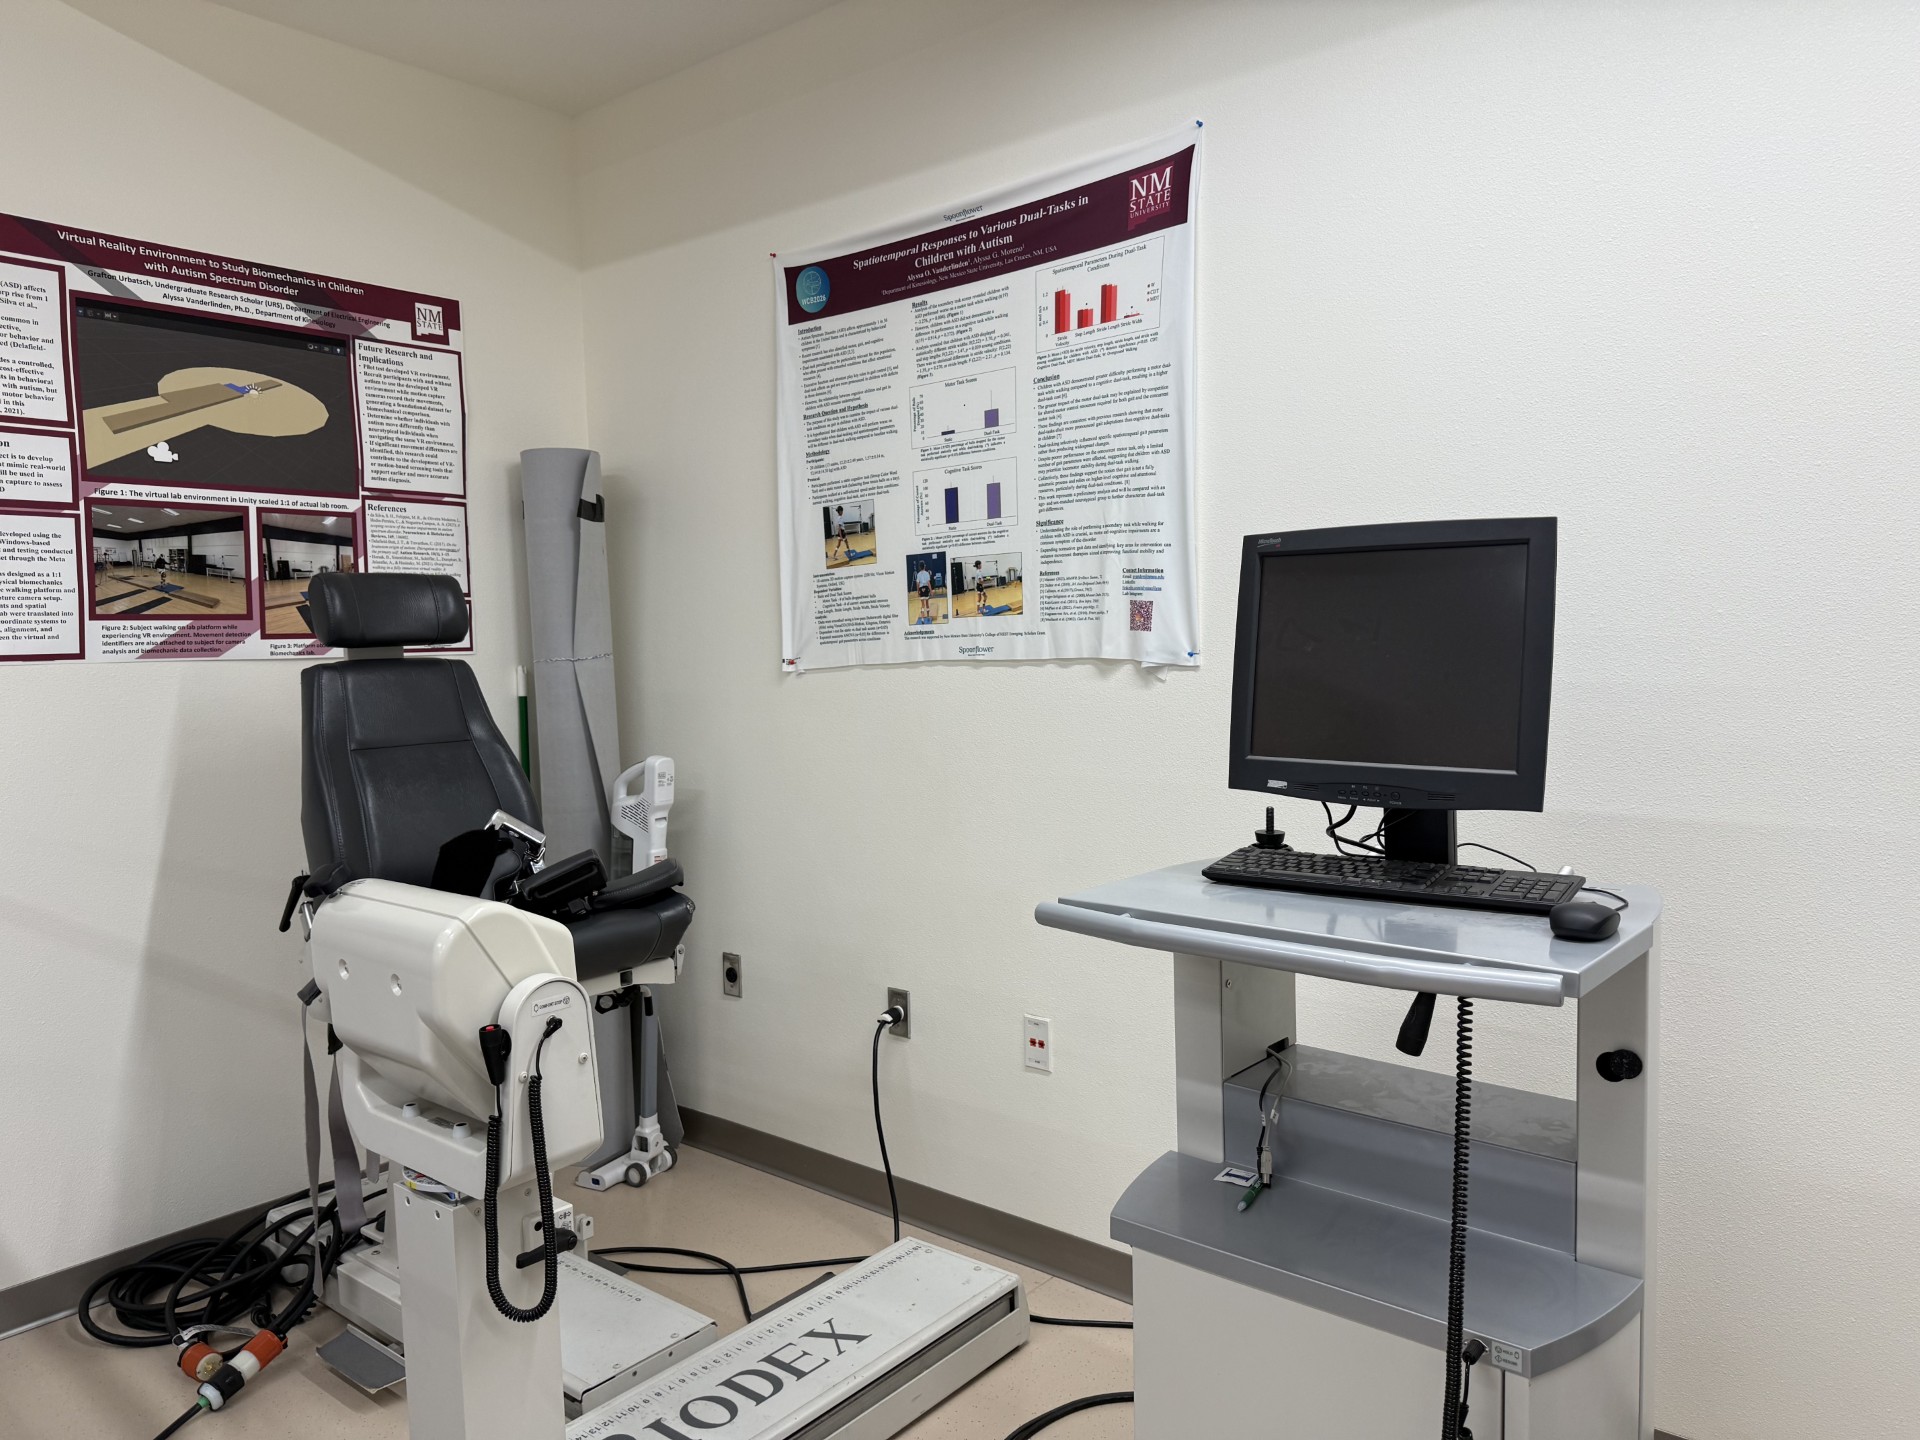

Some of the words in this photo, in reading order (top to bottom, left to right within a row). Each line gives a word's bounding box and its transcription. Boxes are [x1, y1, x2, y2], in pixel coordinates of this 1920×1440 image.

[1130, 166, 1173, 201] NM
[1129, 189, 1171, 213] STATE
[1129, 201, 1170, 219] UNIVERSITY
[943, 205, 983, 222] Spoonflower
[853, 243, 919, 272] Spatiotemporal
[921, 231, 967, 254] Responses
[969, 229, 978, 239] to
[980, 217, 1016, 236] Various
[1020, 199, 1076, 224] Dual-Tasks
[1078, 194, 1089, 207] in
[915, 250, 954, 268] Children
[956, 243, 977, 257] with
[978, 233, 1013, 251] Autism
[57, 231, 96, 246] Virtual
[100, 239, 136, 256] Reality
[140, 246, 206, 266] Environment
[208, 260, 220, 269] to
[222, 261, 249, 276] Study
[252, 267, 316, 286] Biomechanics
[318, 279, 326, 288] in
[328, 281, 365, 296] Children
[907, 270, 924, 282] Alyssa
[973, 253, 990, 266] Alyssa
[992, 251, 999, 259] G.
[0, 280, 22, 290] (ASD)
[23, 284, 46, 293] affects
[144, 262, 168, 273] with
[171, 266, 207, 280] Autism
[210, 273, 256, 290] Spectrum
[259, 281, 298, 296] Disorder
[87, 270, 116, 280] Grafton
[118, 275, 152, 288] Urbatsch,
[154, 281, 206, 297] Undergraduate
[209, 291, 238, 301] Research
[240, 296, 263, 305] Scholar
[266, 300, 285, 310] (URS),
[286, 304, 322, 317] Department
[332, 312, 357, 322] Electrical
[358, 317, 391, 329] Engineering
[801, 294, 826, 306] WCB2026
[162, 293, 184, 303] Alyssa
[185, 296, 233, 311] Vanderlinden,
[255, 308, 293, 322] Department
[302, 316, 335, 329] Kinesiology
[416, 307, 441, 323] NM
[417, 320, 443, 331] STATE
[358, 342, 383, 354] Future
[385, 347, 418, 359] Research
[419, 352, 433, 361] and
[358, 353, 404, 368] Implications
[1033, 374, 1060, 384] Conclusion
[30, 463, 66, 471] real-world
[93, 488, 118, 497] Figure
[184, 494, 229, 502] environment
[367, 503, 407, 513] References
[601, 1317, 873, 1440] IODEX
